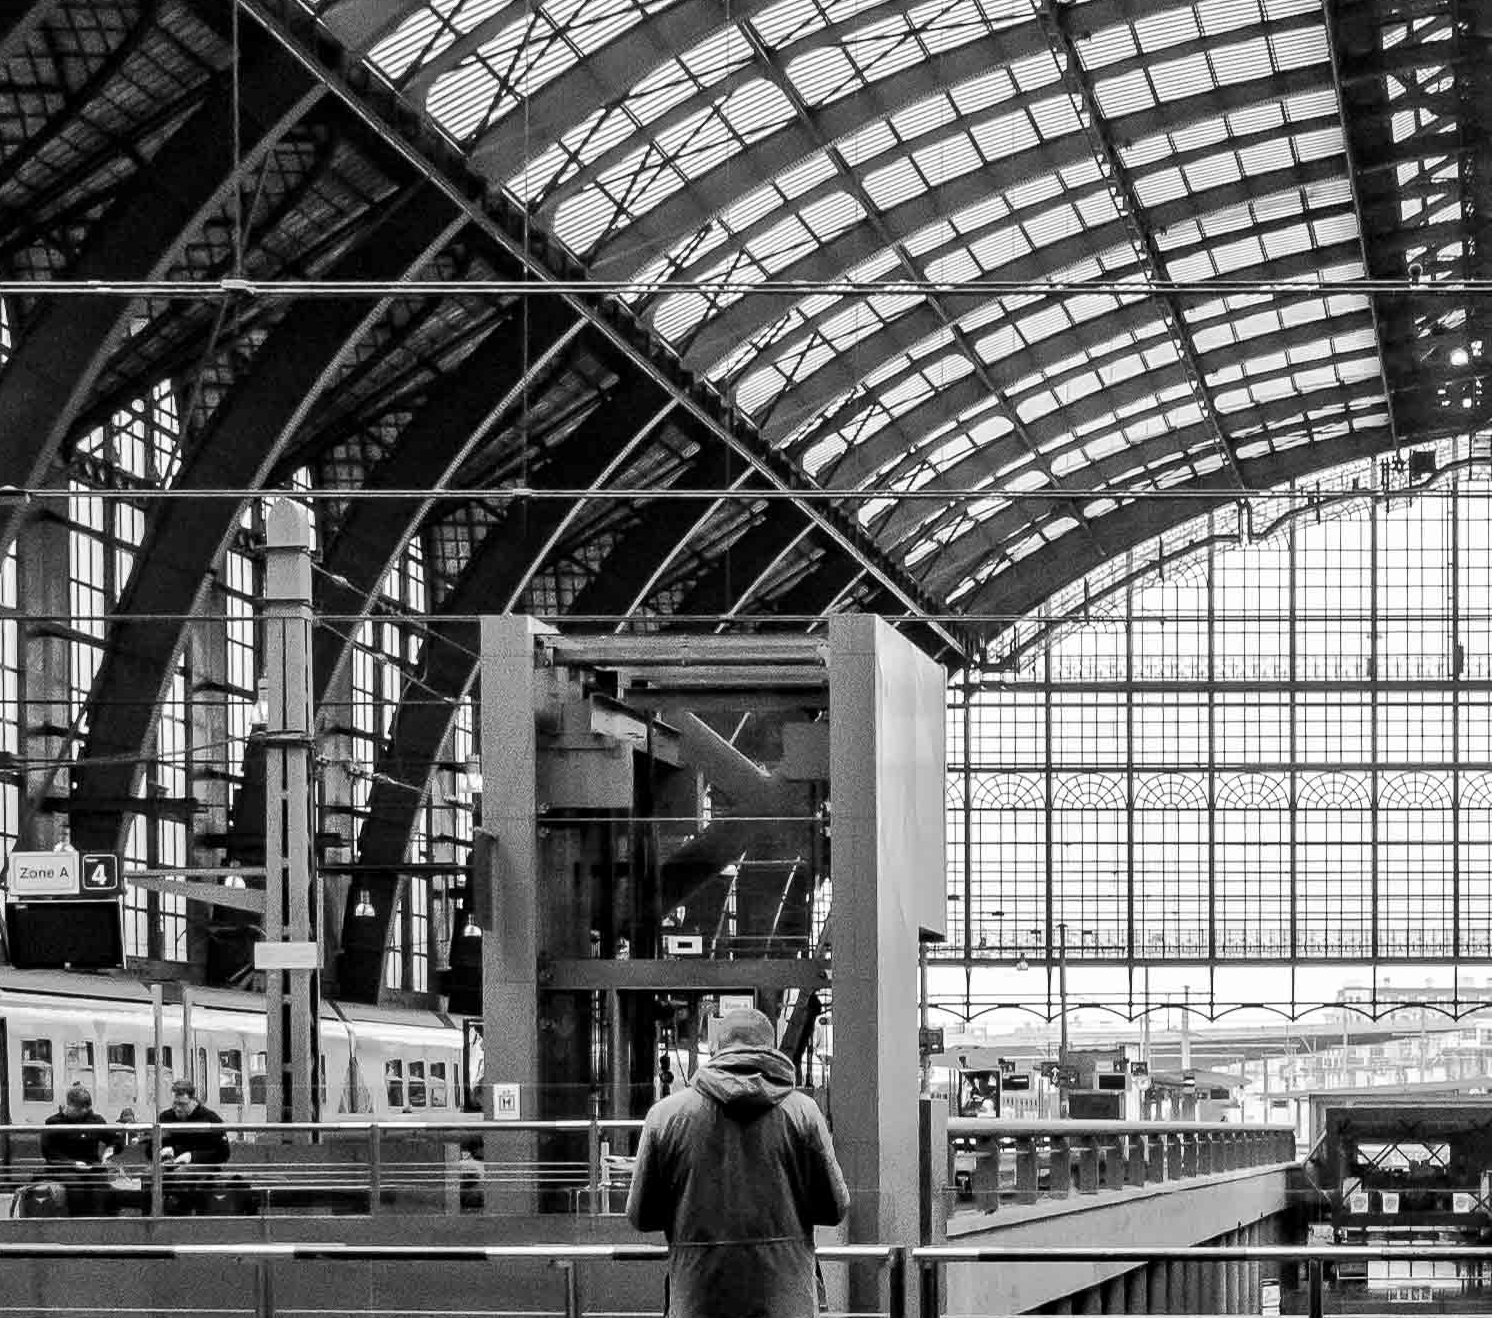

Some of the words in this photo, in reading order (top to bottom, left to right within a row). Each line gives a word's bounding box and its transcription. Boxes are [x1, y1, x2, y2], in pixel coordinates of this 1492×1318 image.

[20, 867, 54, 879] Zone
[59, 866, 69, 878] A
[92, 864, 107, 885] 4
